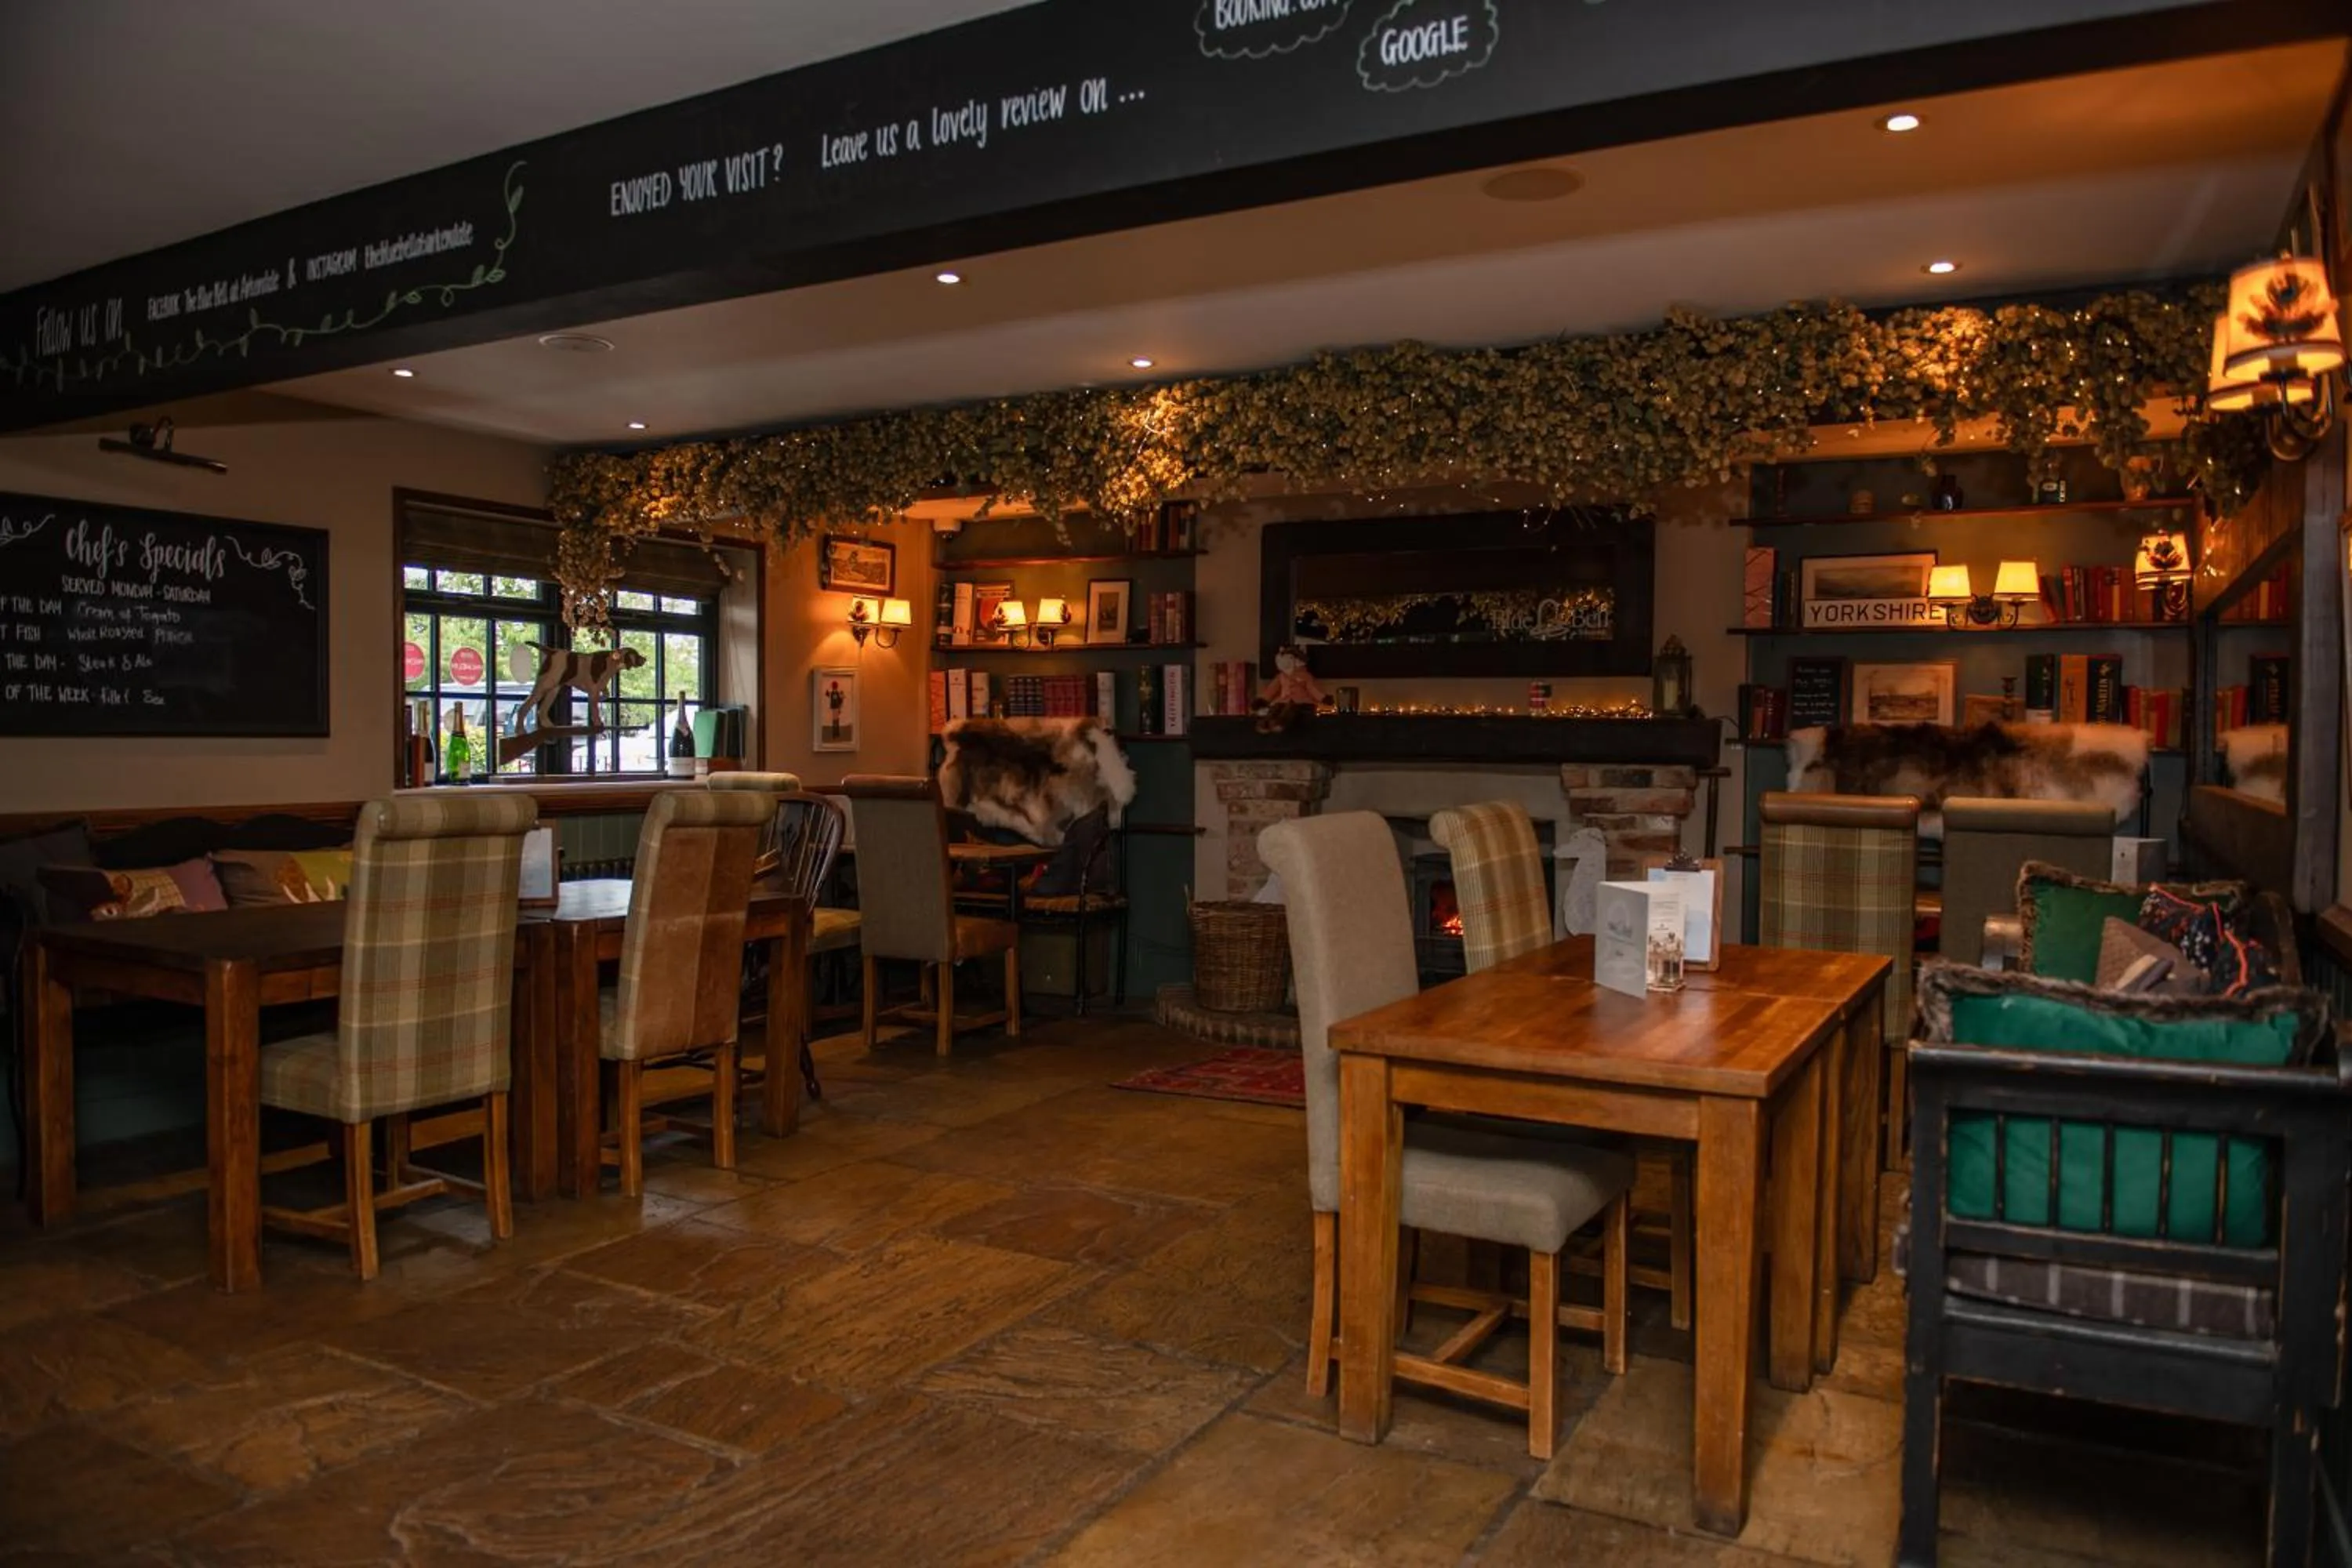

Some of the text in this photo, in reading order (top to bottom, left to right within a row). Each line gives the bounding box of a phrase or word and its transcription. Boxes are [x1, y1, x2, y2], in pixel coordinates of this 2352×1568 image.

[1381, 15, 1468, 66] GOOGLE
[821, 130, 868, 169] Leave
[876, 122, 899, 156] us
[906, 120, 922, 151] a
[931, 100, 988, 148] lovely
[1002, 85, 1067, 130] review
[1080, 77, 1109, 114] on
[611, 171, 672, 216] ENJOYED
[678, 159, 718, 201] YOUR
[306, 248, 357, 282] INSTAGRAM
[66, 519, 226, 584] Chef's Specials
[62, 575, 105, 596] SERVED
[111, 581, 153, 600] MONDAY
[163, 584, 212, 604] SATURDAY
[12, 596, 33, 613] THE
[39, 598, 62, 615] DAY
[1810, 602, 1943, 623] YORKSHIRE
[16, 622, 41, 641] FISH
[1491, 608, 1609, 630] Blue Bell
[5, 652, 28, 670] THE
[5, 684, 21, 700] OF
[27, 684, 53, 702] THE
[58, 684, 91, 703] WEEK
